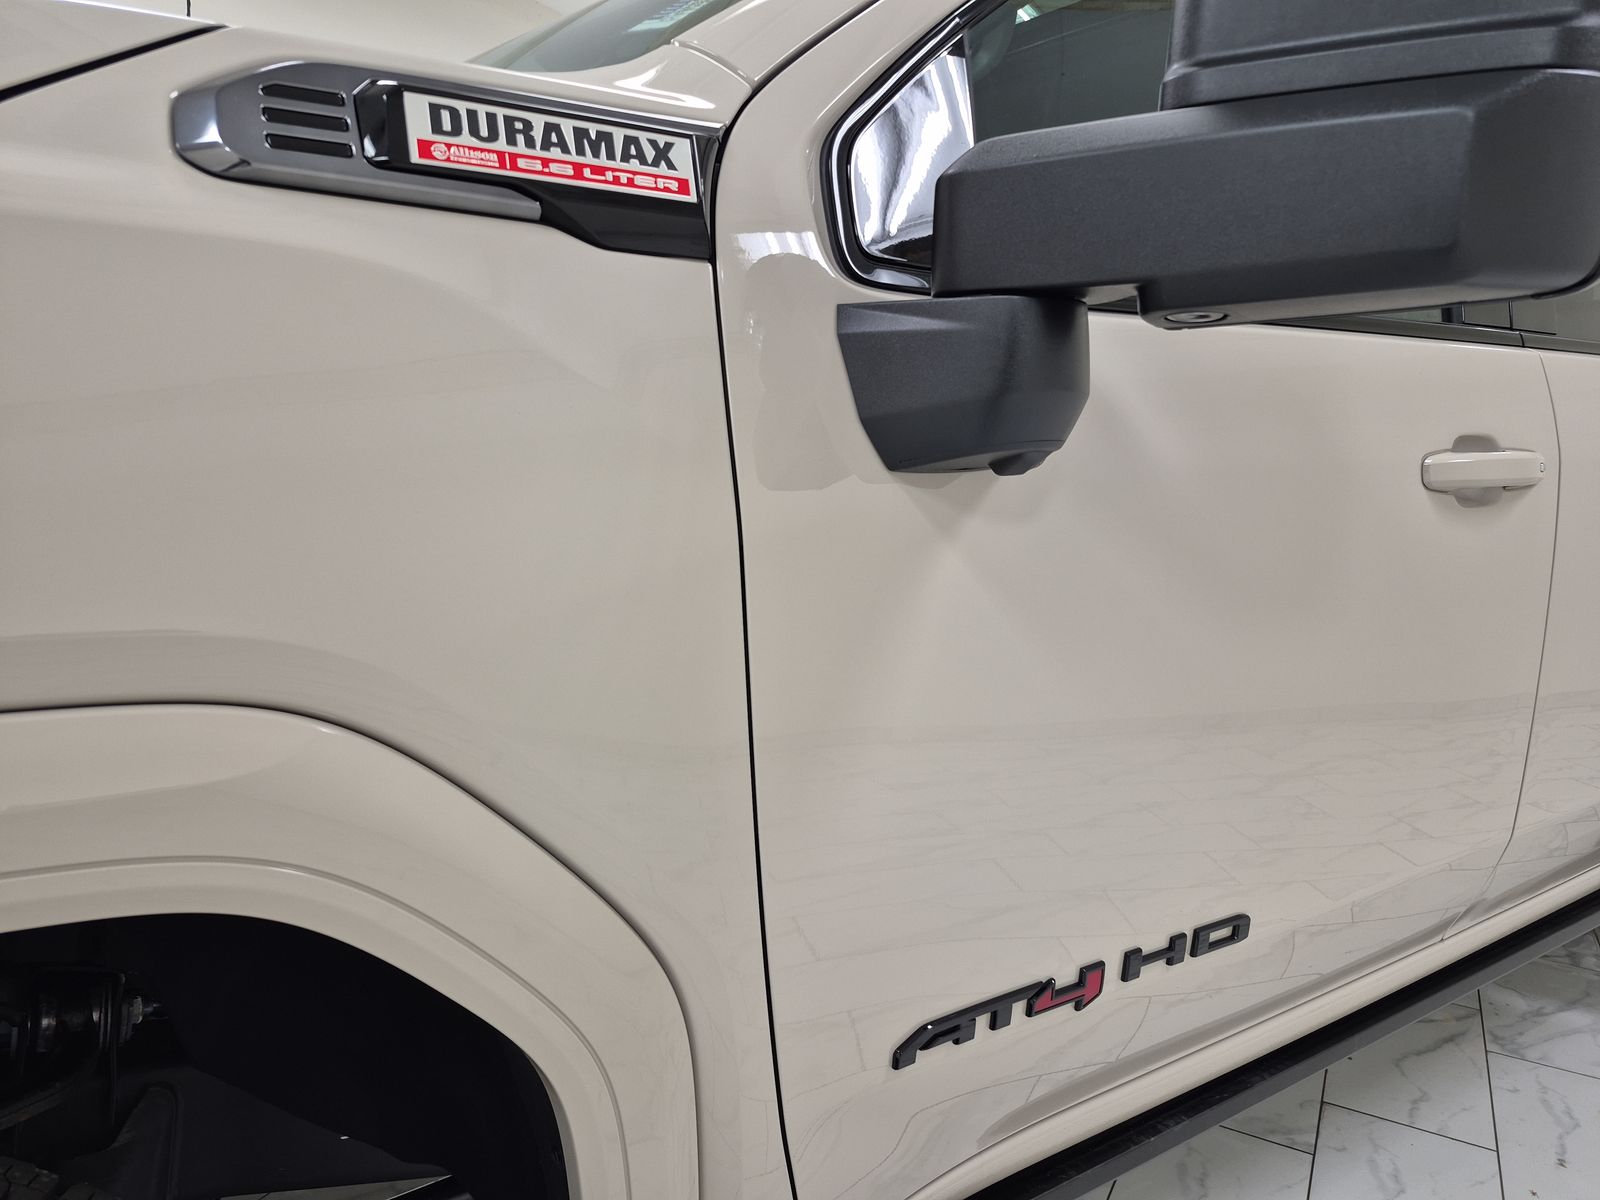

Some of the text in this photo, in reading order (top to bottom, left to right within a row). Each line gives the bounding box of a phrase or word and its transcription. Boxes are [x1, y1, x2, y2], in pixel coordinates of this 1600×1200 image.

[428, 102, 679, 172] DURAMAX
[450, 145, 498, 163] Allison
[583, 167, 679, 191] LITER
[891, 913, 1251, 1070] AT4 HD
